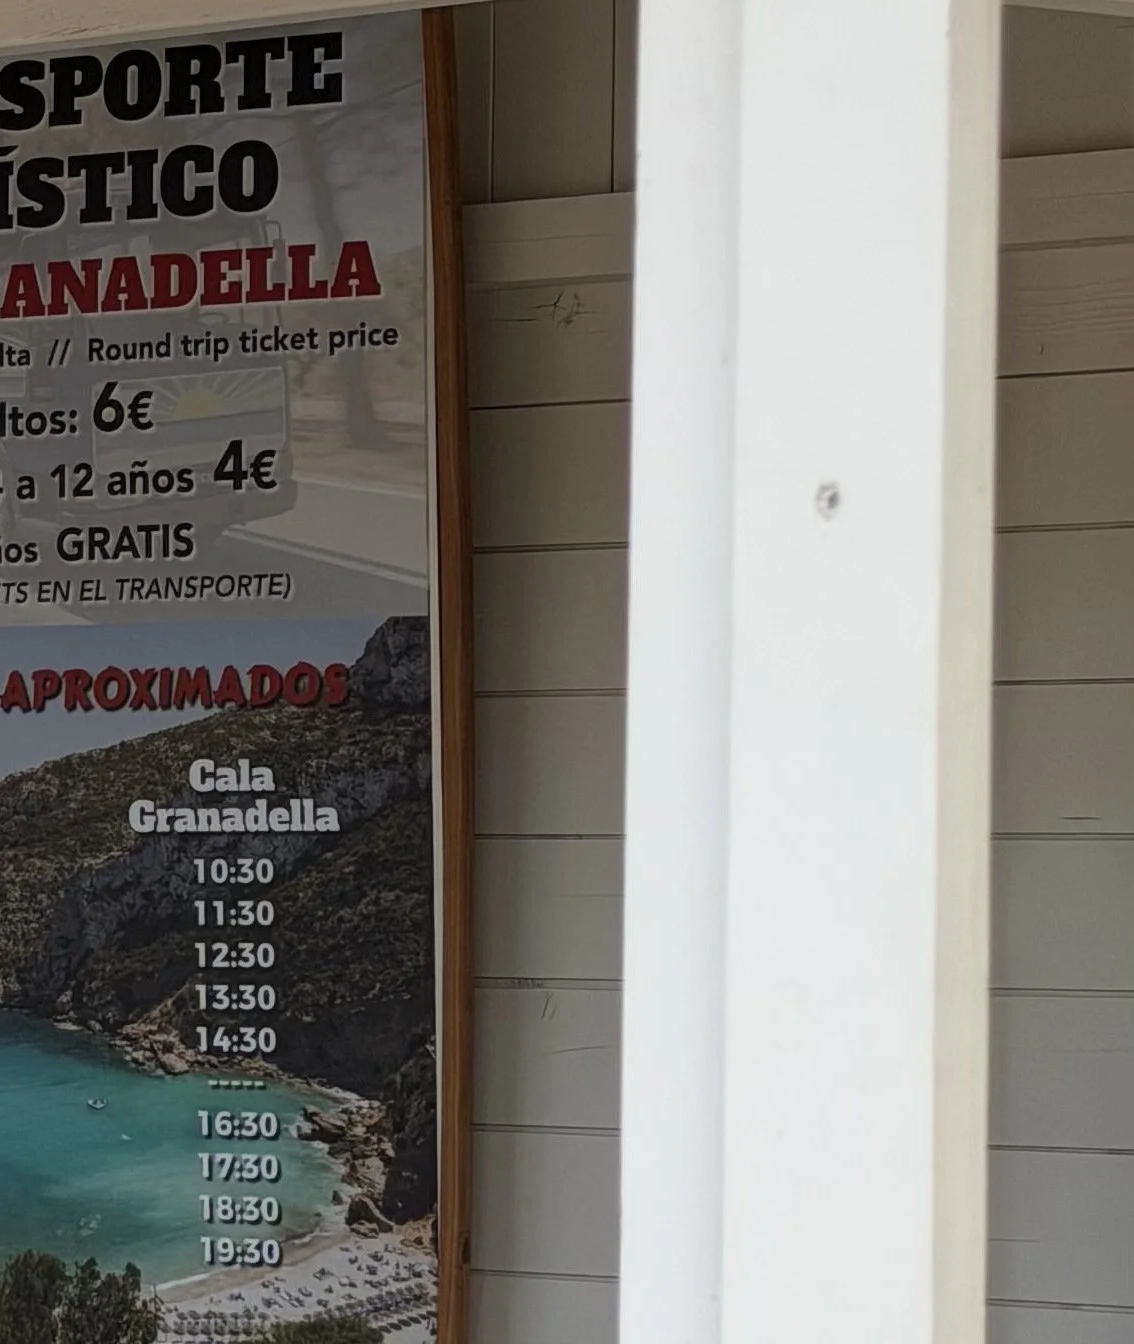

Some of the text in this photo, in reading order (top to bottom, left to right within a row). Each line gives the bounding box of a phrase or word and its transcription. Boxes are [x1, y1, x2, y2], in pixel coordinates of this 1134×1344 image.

[88, 333, 171, 363] Round
[180, 331, 229, 363] trip
[239, 326, 319, 355] ticket
[328, 323, 399, 355] price
[92, 382, 155, 433] 6€
[18, 476, 35, 500] a
[50, 464, 94, 498] 12
[107, 460, 194, 497] años
[214, 440, 278, 492] 4€
[56, 524, 194, 562] GRATIS
[37, 579, 73, 604] EN
[78, 577, 107, 602] EL
[115, 573, 292, 603] TRANSPORTE)
[0, 662, 348, 713] APROXIMADOS
[189, 759, 274, 793] Cala
[128, 800, 340, 834] Granadella
[193, 858, 274, 885] 10:30
[193, 900, 274, 927] 11:30
[194, 943, 275, 969] 12:30
[195, 985, 275, 1012] 13:30
[195, 1027, 276, 1054] 14:30
[198, 1111, 278, 1138] 16:30
[198, 1154, 279, 1181] 17:30
[200, 1196, 280, 1223] 18:30
[201, 1238, 281, 1265] 19:30
